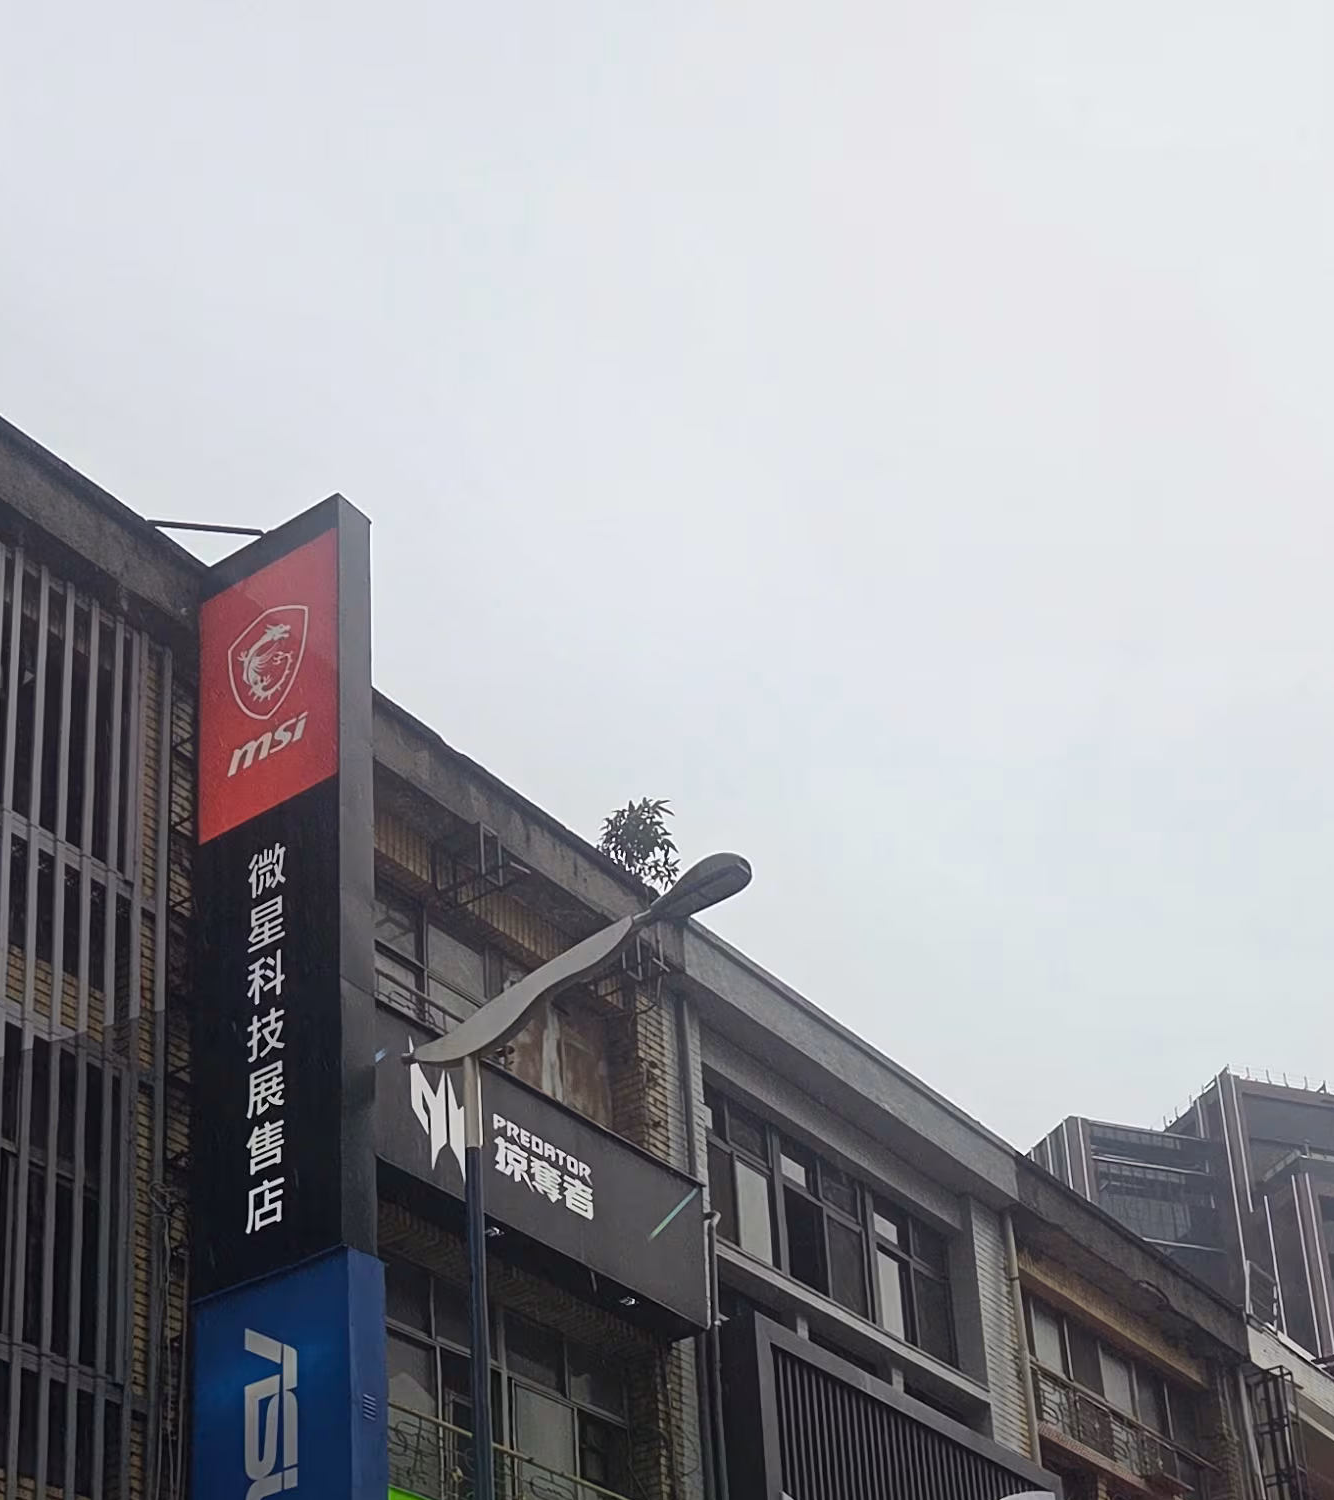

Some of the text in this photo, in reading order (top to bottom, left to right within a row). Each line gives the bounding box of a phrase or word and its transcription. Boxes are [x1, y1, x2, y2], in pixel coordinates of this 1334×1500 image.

[227, 712, 308, 777] msi
[245, 842, 287, 1235] 微星科技展售店
[492, 1113, 593, 1184] PREDATOR
[493, 1139, 595, 1221] 掠奪者
